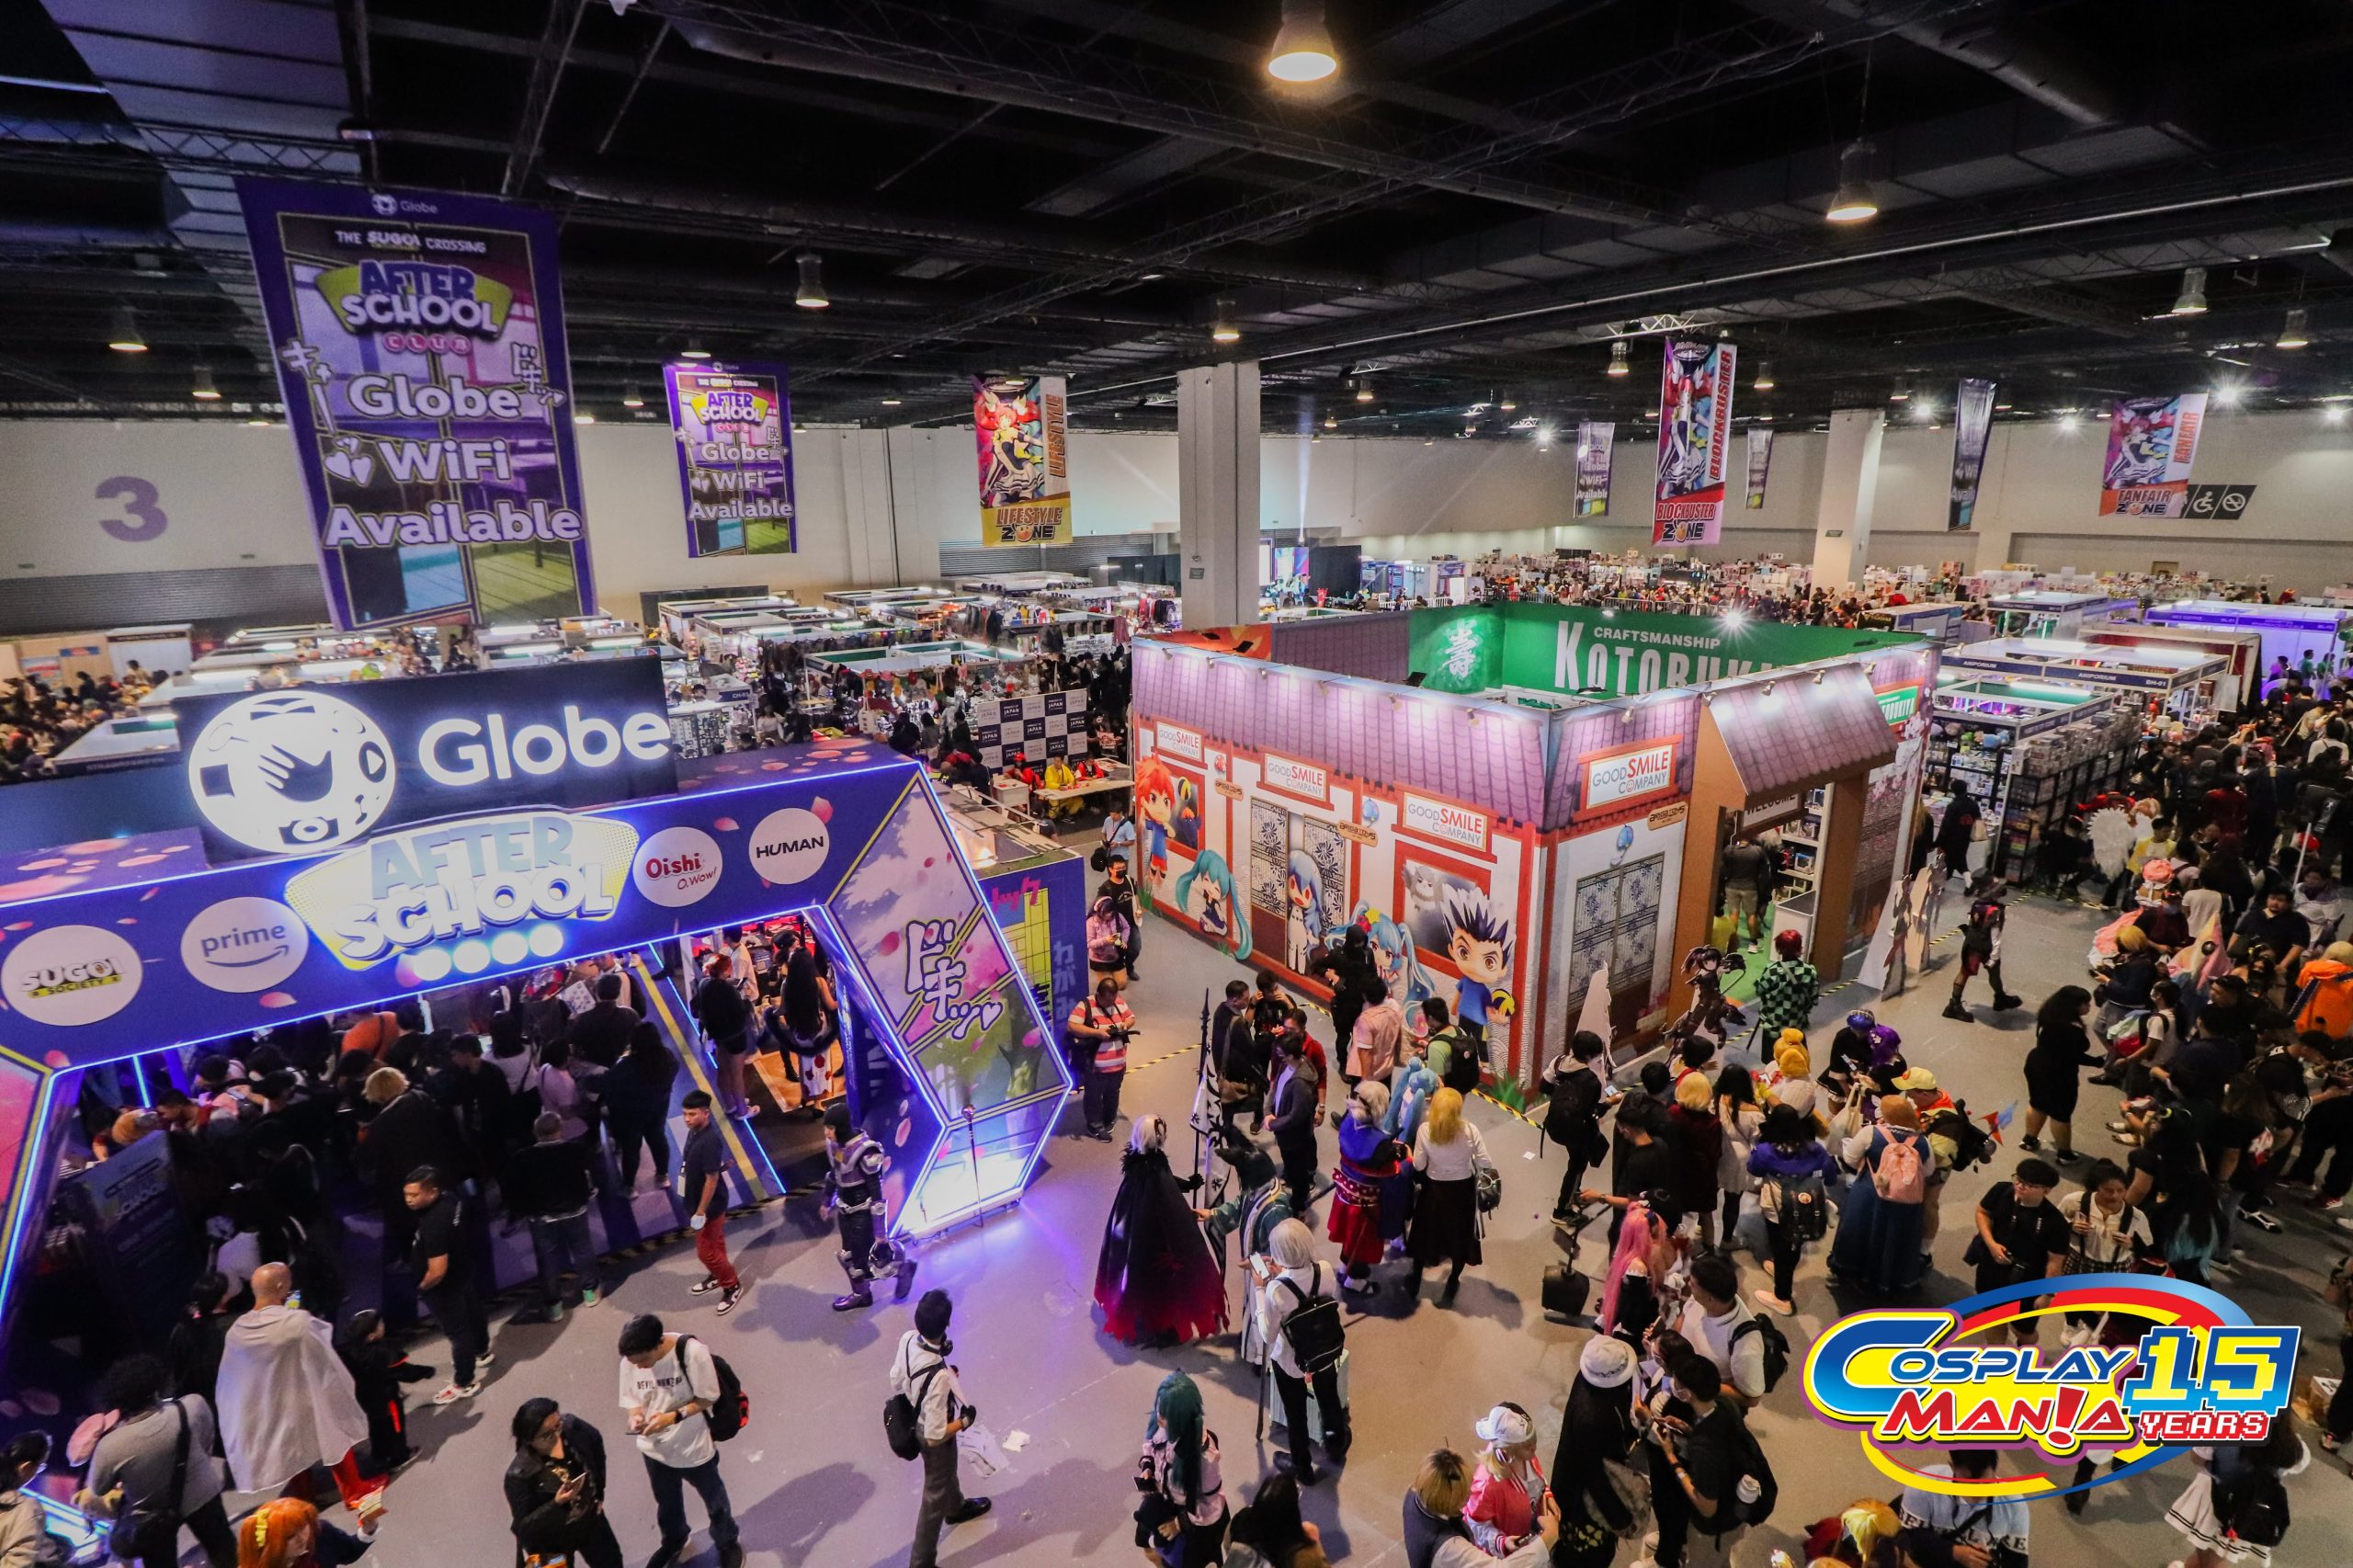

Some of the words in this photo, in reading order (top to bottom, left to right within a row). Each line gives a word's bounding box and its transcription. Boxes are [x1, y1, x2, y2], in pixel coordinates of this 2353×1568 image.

[400, 199, 438, 214] Globe
[335, 231, 362, 244] THE
[425, 237, 487, 253] CROSSING
[358, 259, 476, 300] AFTER
[341, 294, 498, 332] SCHOOL
[347, 373, 522, 418] Globe
[707, 391, 754, 408] AFTER
[699, 404, 764, 423] SCHOOL
[1709, 350, 1733, 481] BLOCKBUSTER
[1045, 393, 1066, 478] LIFESTYLE
[2173, 412, 2200, 463] FANFAIR
[376, 437, 512, 482] WiFi
[701, 442, 770, 461] Globe
[712, 471, 764, 490] WiFi
[2117, 489, 2172, 504] FANFAIR
[96, 476, 168, 542] 3
[688, 498, 793, 519] Available
[995, 506, 1063, 526] LIFESTYLE
[1655, 502, 1716, 521] BLOCKBUSTER
[2116, 502, 2166, 516] ZONE
[324, 500, 583, 546] Available
[1001, 524, 1055, 542] ZONE
[1662, 520, 1704, 542] ZONE
[1594, 626, 1721, 650] CRAFTSMANSHIP
[1004, 708, 1019, 716] JAPAN
[1048, 701, 1063, 710] JAPAN
[1027, 725, 1042, 733] JAPAN
[1070, 719, 1086, 727] JAPAN
[419, 705, 671, 787] Globe
[983, 733, 998, 741] JAPAN
[1050, 744, 1065, 752] JAPAN
[1268, 762, 1291, 777] GOOD
[1291, 766, 1323, 787] SMILE
[1593, 767, 1627, 788] GOOD
[1627, 751, 1669, 778] SMILE
[1286, 778, 1323, 796] COMPANY
[1618, 771, 1667, 795] COMPANY
[1408, 803, 1440, 822] GOOD
[1440, 808, 1483, 835] SMILE
[1432, 822, 1482, 846] COMPANY
[756, 835, 824, 858] HUMAN
[369, 816, 574, 900] AFTER
[645, 852, 702, 879] Oishi
[335, 862, 615, 960] SCHOOL
[200, 925, 287, 957] prime
[48, 978, 105, 995] SOCIETY
